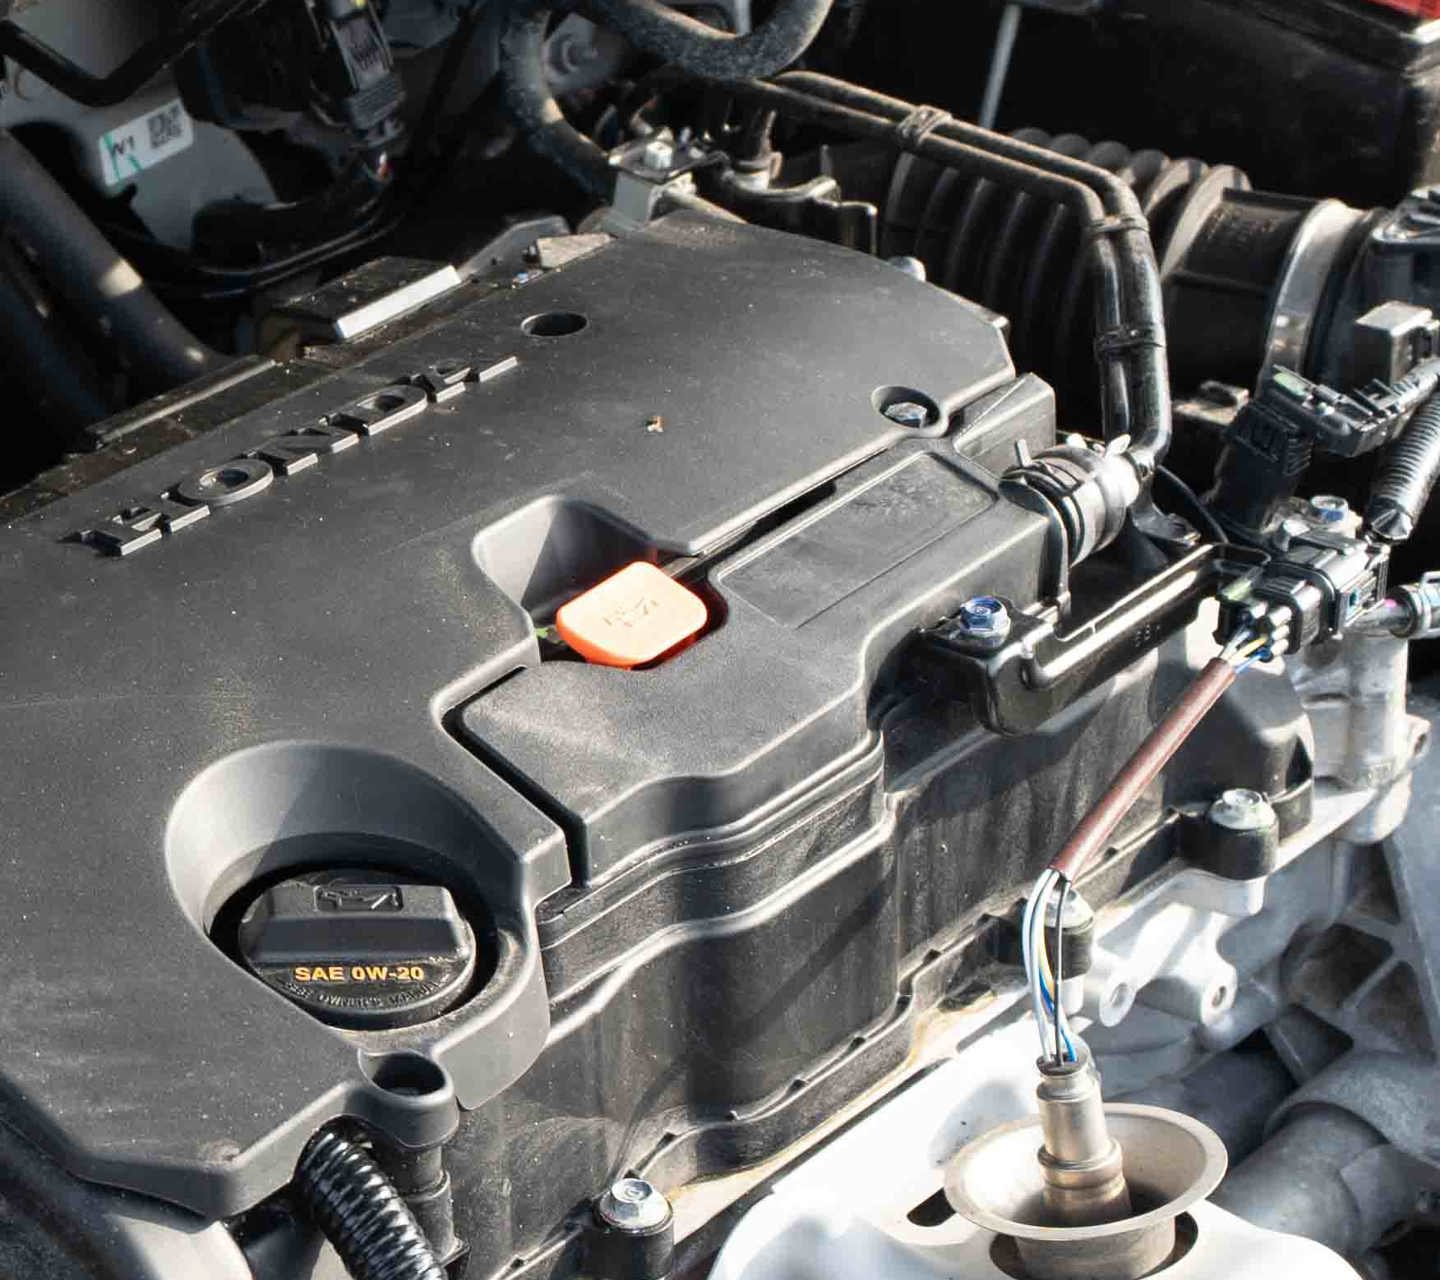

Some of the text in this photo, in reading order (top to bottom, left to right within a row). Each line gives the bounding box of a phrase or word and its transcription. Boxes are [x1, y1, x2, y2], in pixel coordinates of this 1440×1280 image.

[82, 354, 518, 556] HONDA
[295, 966, 424, 981] SAE 0W-20
